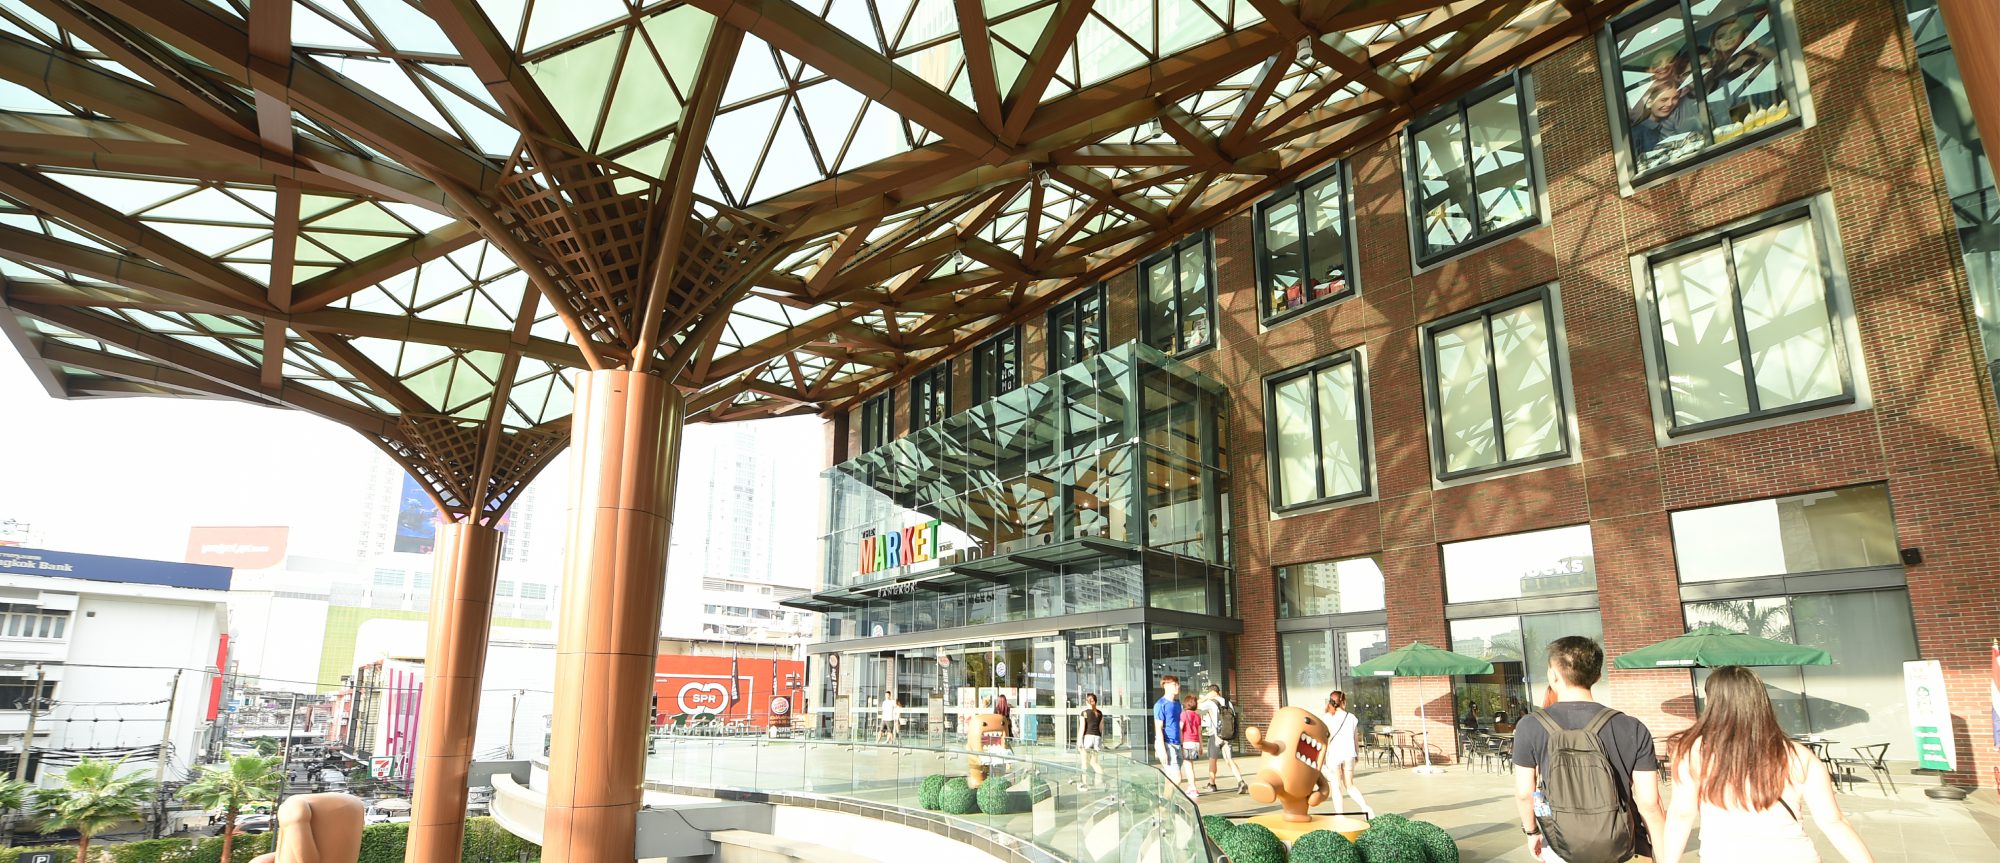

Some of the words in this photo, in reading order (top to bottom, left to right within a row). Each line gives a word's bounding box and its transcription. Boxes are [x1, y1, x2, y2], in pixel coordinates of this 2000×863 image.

[860, 518, 942, 575] MARKET
[39, 561, 73, 572] Bank
[877, 581, 918, 598] BANGKOK
[692, 693, 716, 703] SPR
